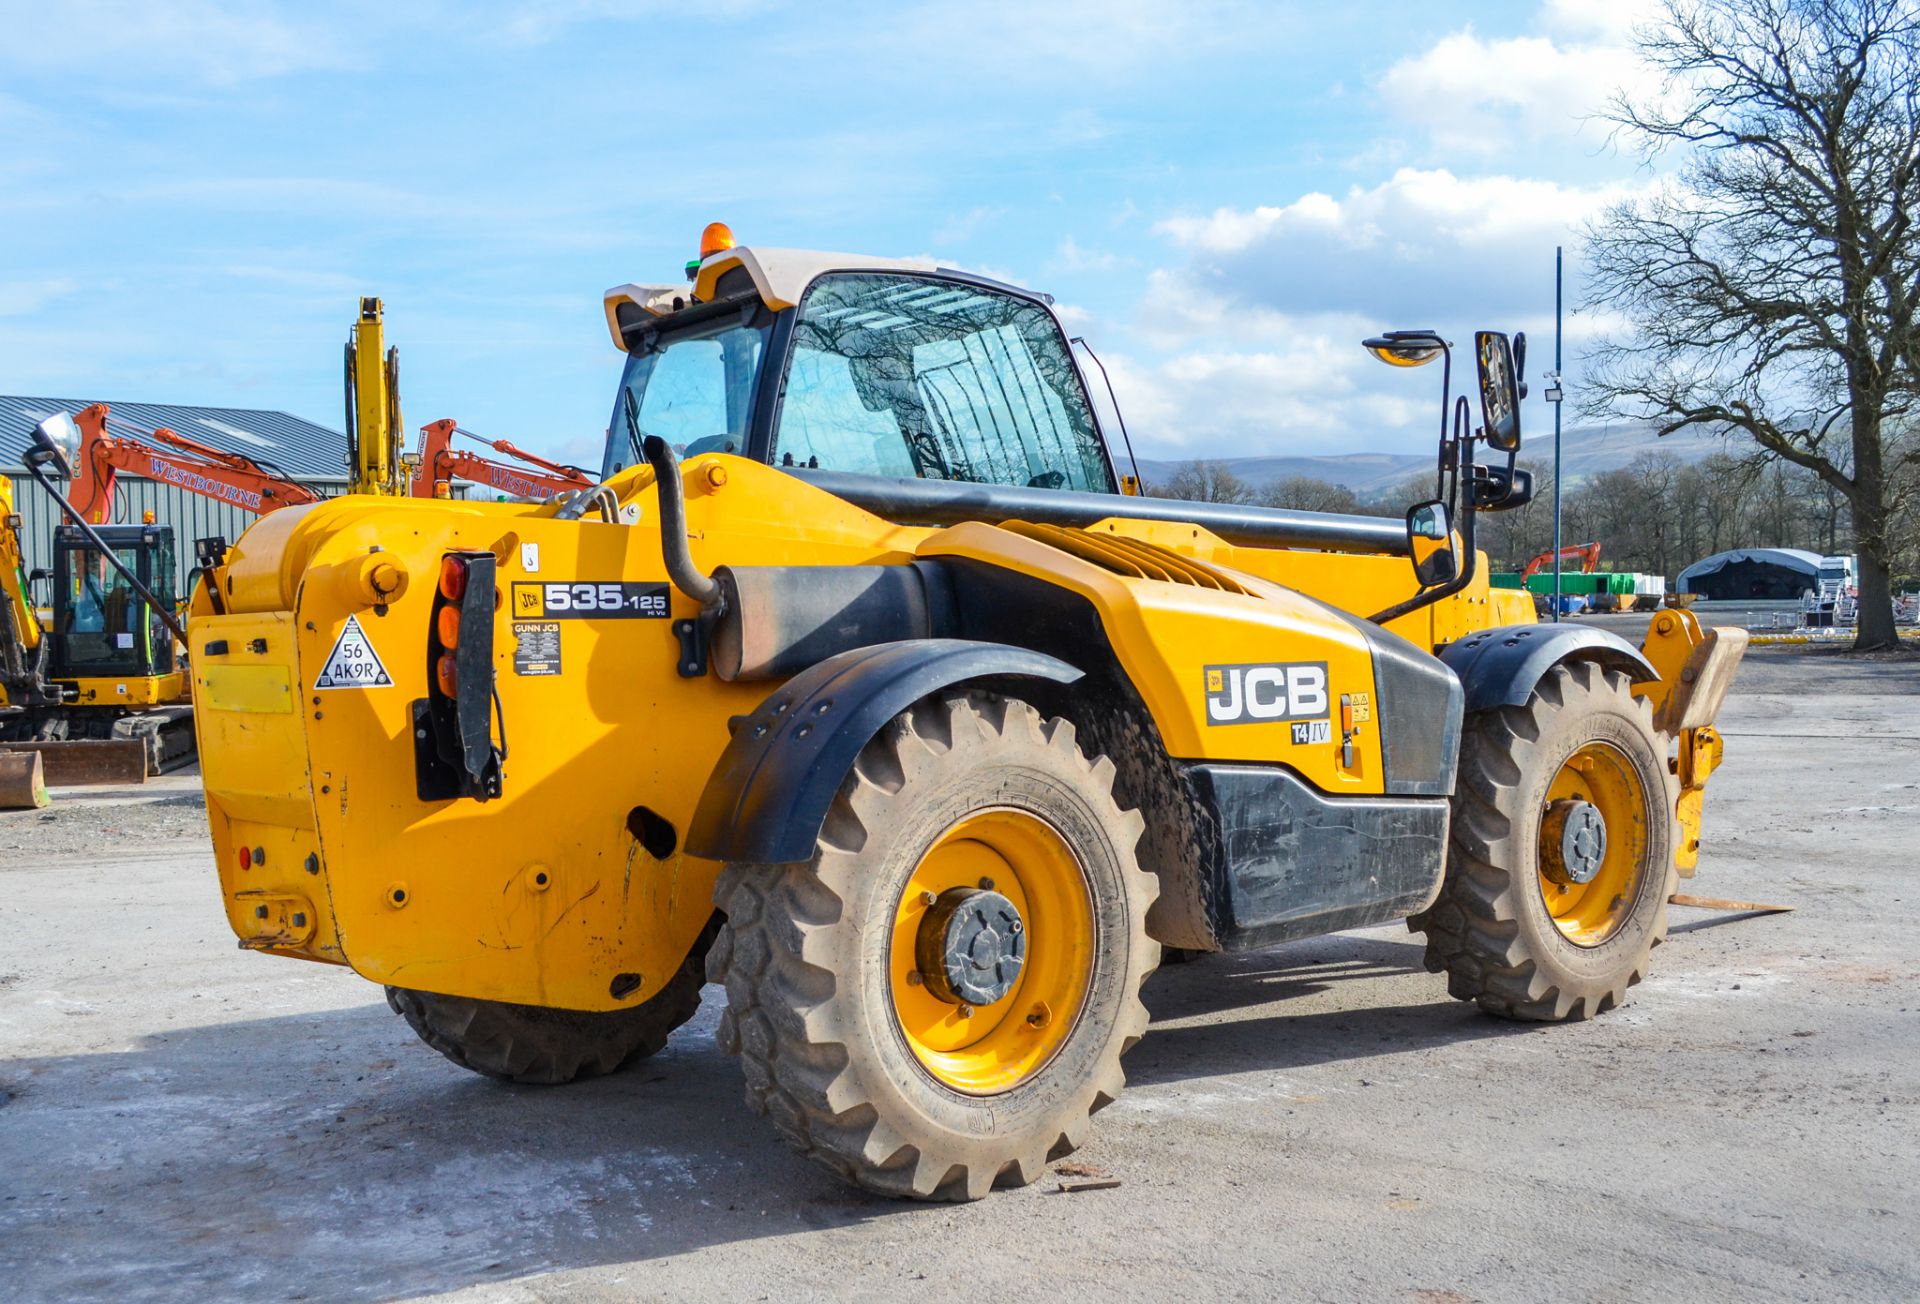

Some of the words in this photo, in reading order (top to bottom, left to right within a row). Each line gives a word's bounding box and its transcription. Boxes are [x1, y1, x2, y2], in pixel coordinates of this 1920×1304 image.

[150, 457, 262, 509] WESTBOURNE
[522, 593, 538, 608] JCB
[545, 584, 666, 610] 535-125
[514, 624, 541, 633] GUNN
[542, 624, 559, 632] JCB
[344, 643, 363, 659] 56
[334, 663, 374, 679] AK9R
[1208, 666, 1327, 721] JCB
[1292, 724, 1309, 743] T4
[1311, 722, 1328, 742] IV
